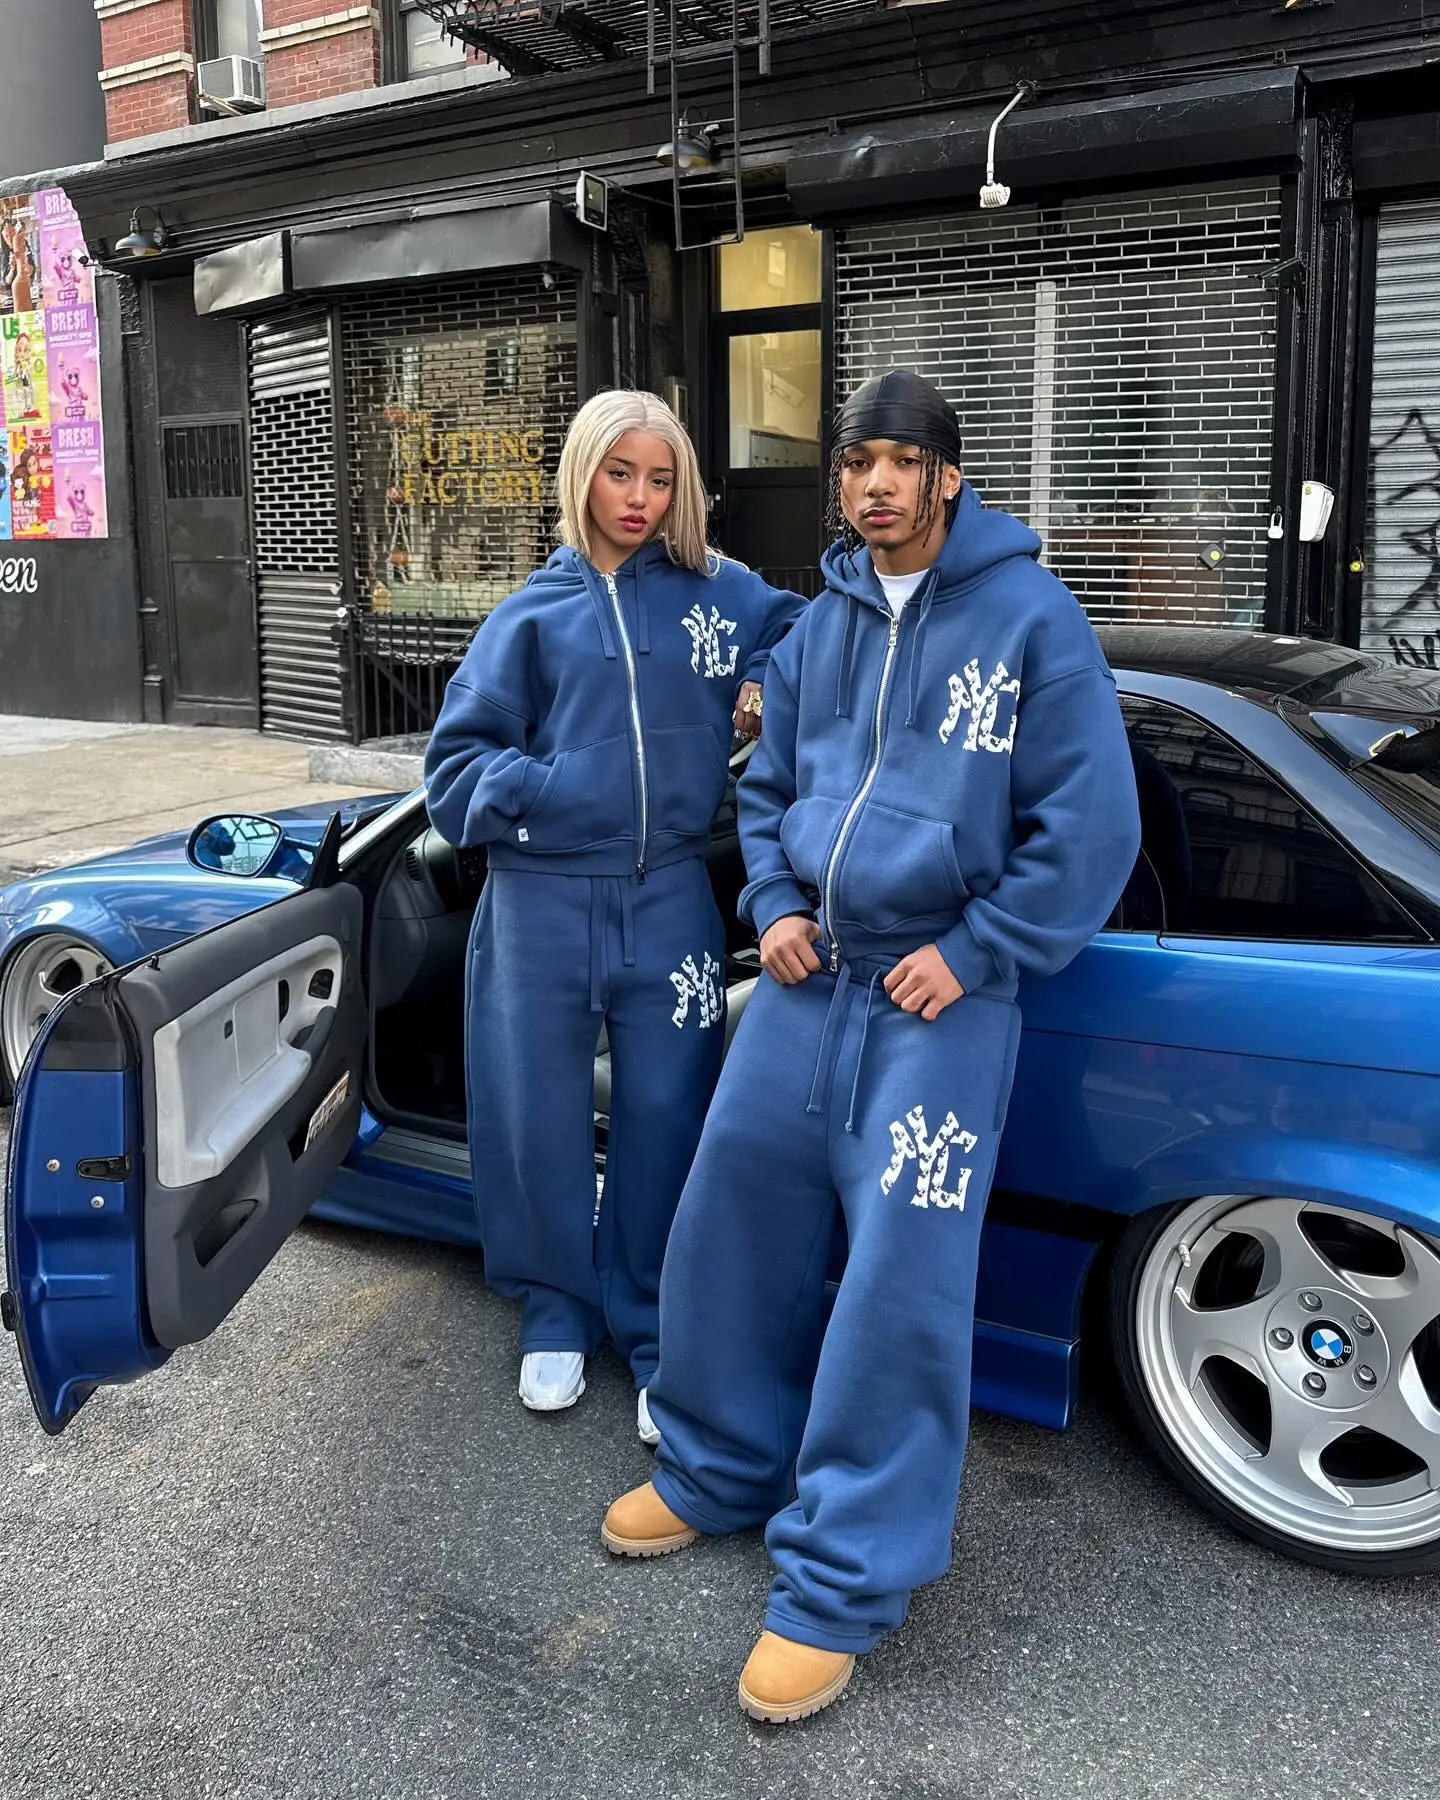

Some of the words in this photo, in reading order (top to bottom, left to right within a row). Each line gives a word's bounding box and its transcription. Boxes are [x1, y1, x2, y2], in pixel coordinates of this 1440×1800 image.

[51, 308, 88, 333] BRESH
[57, 426, 95, 449] BRESH
[400, 428, 545, 465] CUTTING
[403, 470, 546, 505] FACTORY
